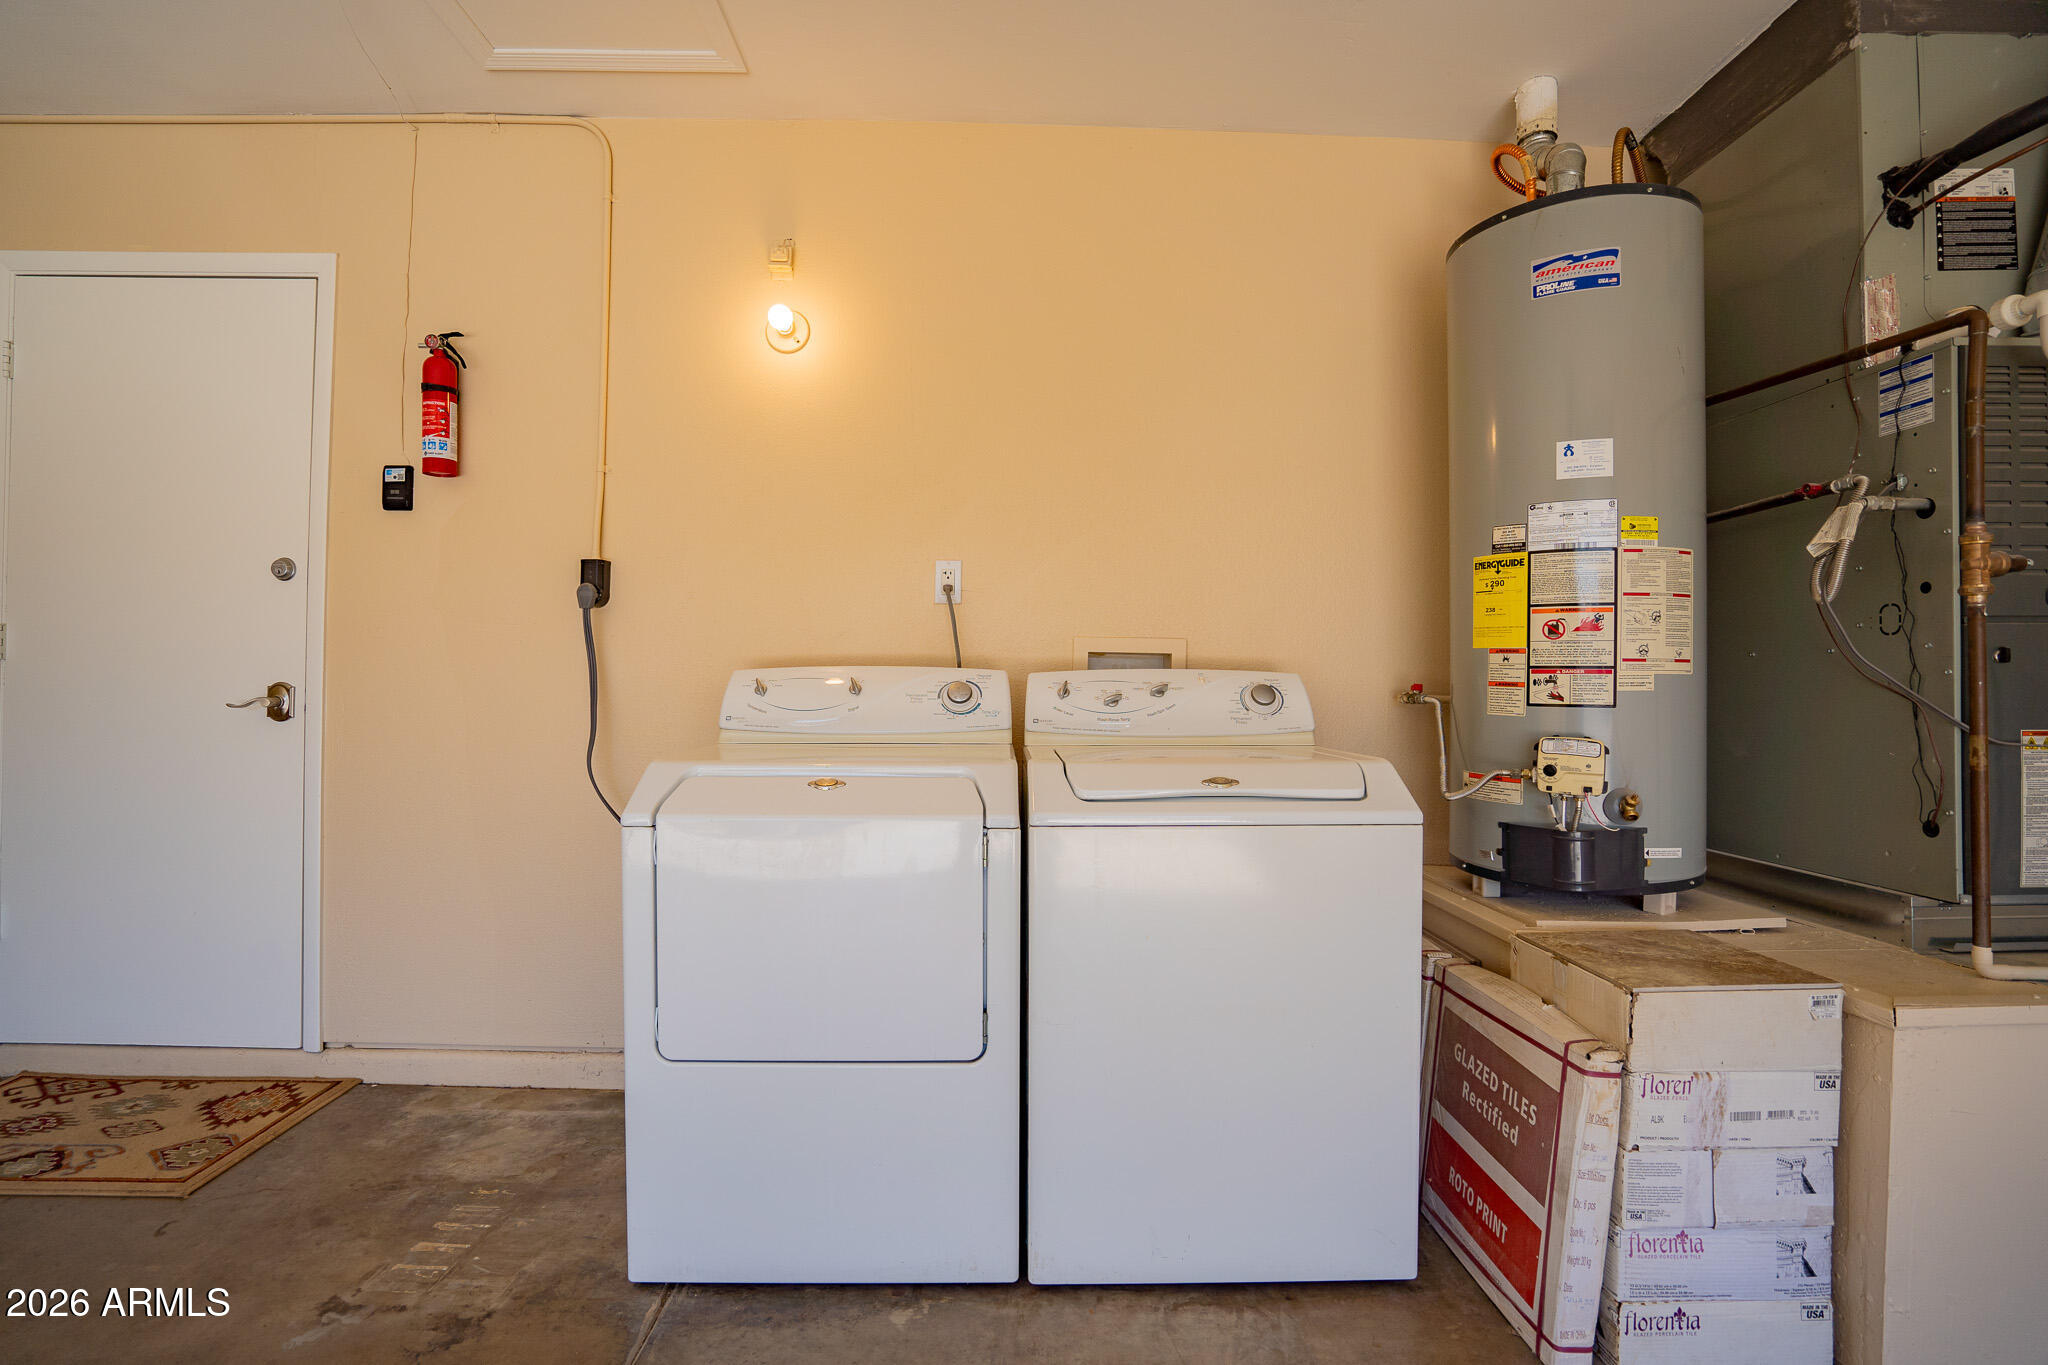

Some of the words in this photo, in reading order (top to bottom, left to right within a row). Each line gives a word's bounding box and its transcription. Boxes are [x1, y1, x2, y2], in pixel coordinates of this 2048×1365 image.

[1536, 260, 1616, 278] american
[1536, 280, 1576, 292] PROLINE
[1474, 558, 1525, 571] ENERGYGUIDE
[1490, 580, 1505, 588] 290
[1454, 1043, 1499, 1092] GLAZED
[1502, 1081, 1538, 1126] TILES
[1640, 1073, 1694, 1099] floren
[1819, 1080, 1837, 1089] USA
[1462, 1080, 1519, 1146] Rectified
[1448, 1166, 1475, 1207] ROTO
[1475, 1195, 1508, 1244] PRINT
[1628, 1230, 1705, 1258] florentia
[1624, 1306, 1701, 1336] florentia
[1806, 1310, 1825, 1319] USA
